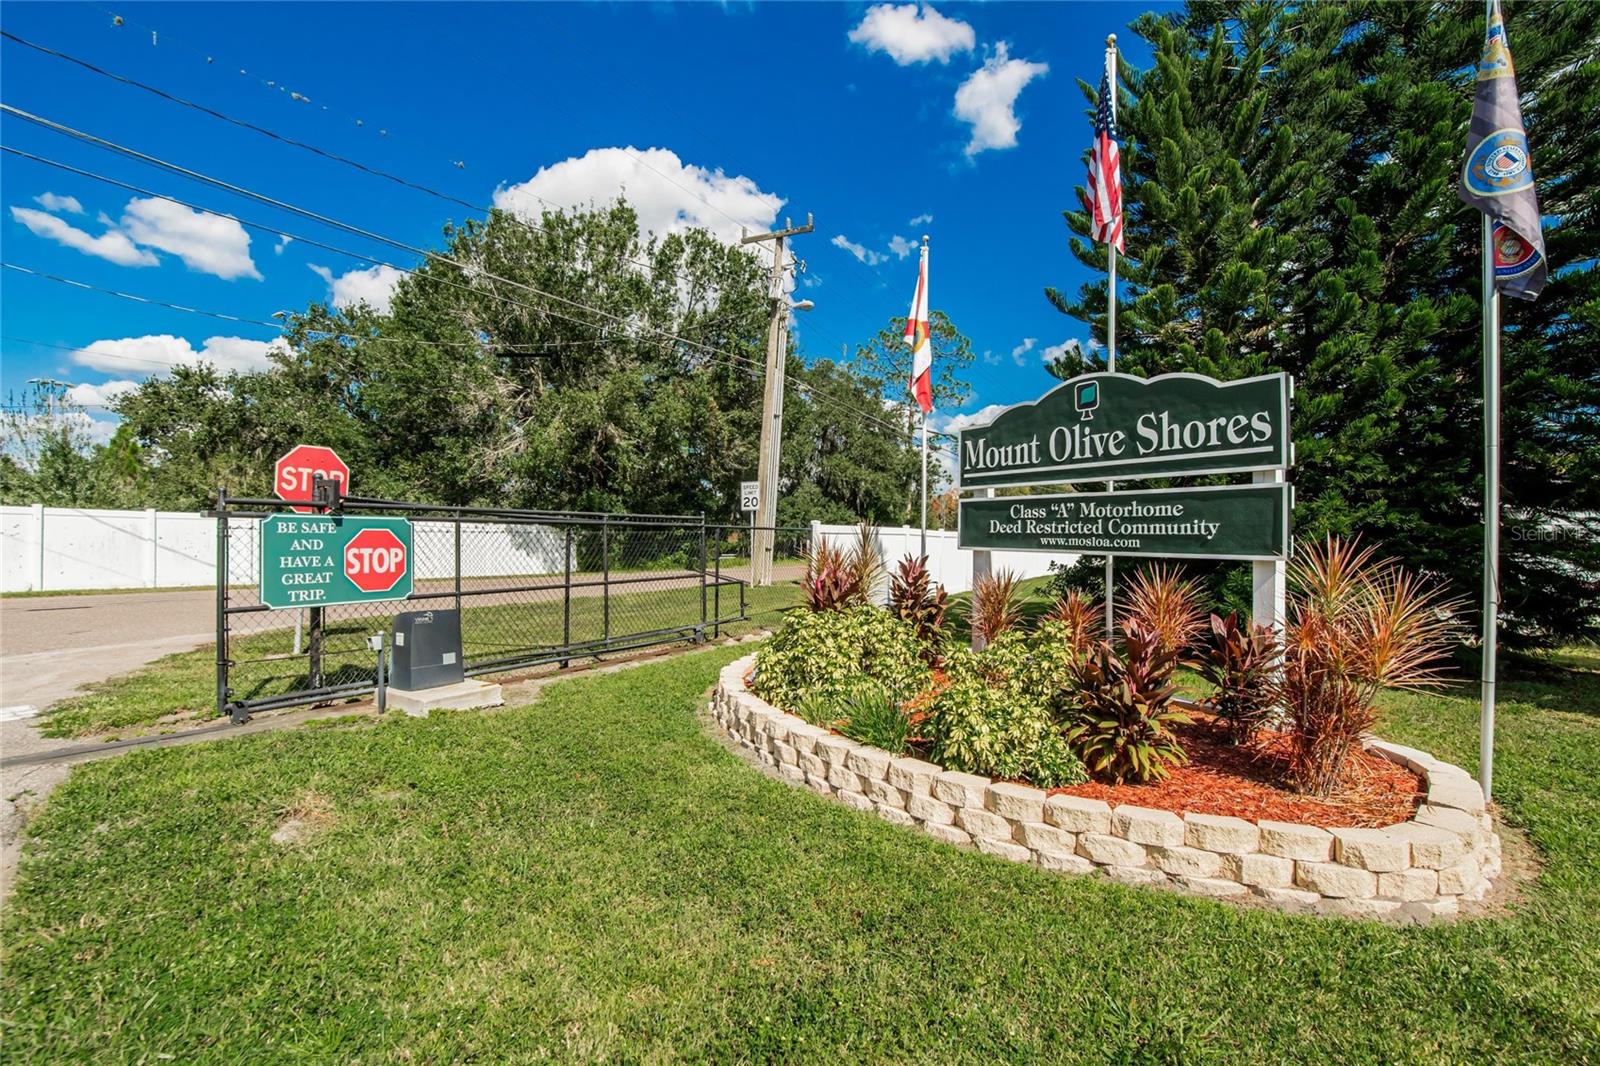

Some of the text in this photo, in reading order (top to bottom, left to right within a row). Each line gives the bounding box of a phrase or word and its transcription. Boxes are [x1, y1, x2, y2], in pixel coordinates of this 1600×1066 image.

[963, 410, 1274, 471] Mount Olive Shores
[281, 466, 345, 492] STP
[743, 497, 759, 508] 20
[1010, 504, 1047, 519] Class
[1080, 501, 1184, 518] Motorhome
[277, 522, 337, 534] BE SAFE
[989, 518, 1221, 539] Deed Restricted Community
[290, 539, 324, 551] AND
[1040, 537, 1141, 548] www.mosloa.com
[279, 556, 335, 568] HAVE A
[346, 547, 404, 575] STOP
[281, 572, 334, 586] GREAT
[287, 590, 327, 602] TRIP.
